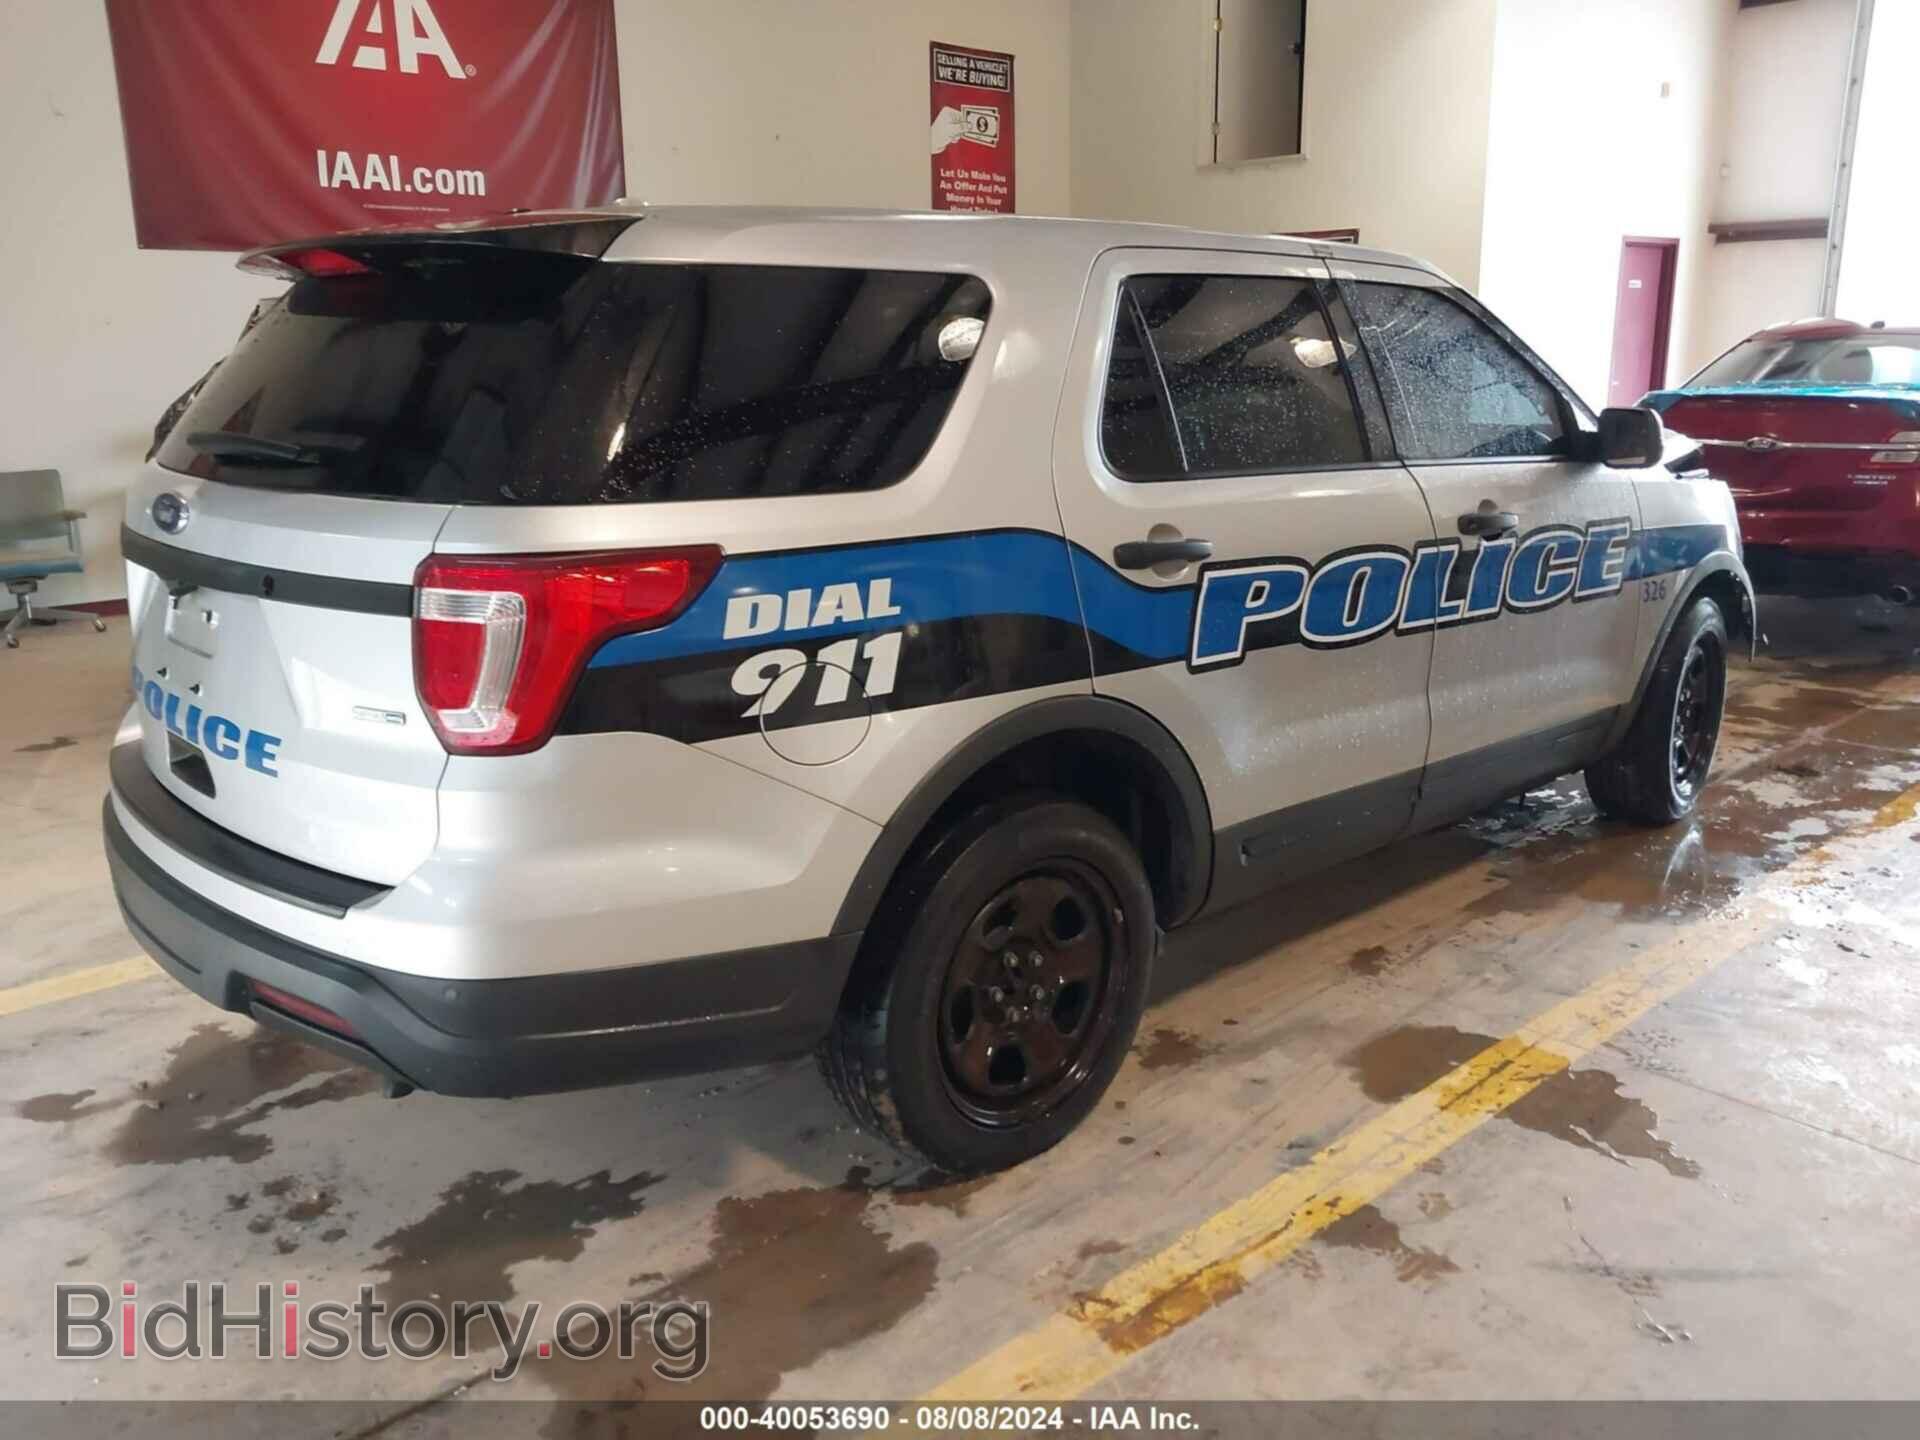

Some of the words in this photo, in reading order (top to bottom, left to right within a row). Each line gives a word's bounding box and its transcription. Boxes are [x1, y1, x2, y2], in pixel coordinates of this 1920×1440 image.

[969, 59, 976, 69] A
[937, 65, 968, 81] WE'RE
[969, 71, 1006, 87] BUYING!
[316, 149, 486, 197] IAAI.com
[940, 168, 955, 177] Let
[957, 168, 969, 178] Us
[970, 170, 991, 180] Make
[992, 173, 1006, 183] You
[940, 180, 952, 190] An
[954, 181, 976, 191] Offer
[978, 183, 992, 193] And
[993, 185, 1007, 194] Put
[946, 192, 975, 205] Money
[976, 194, 984, 204] In
[1189, 518, 1632, 672] POLICE
[1641, 579, 1667, 603] 326
[723, 578, 901, 640] DIAL
[731, 632, 903, 718] 911
